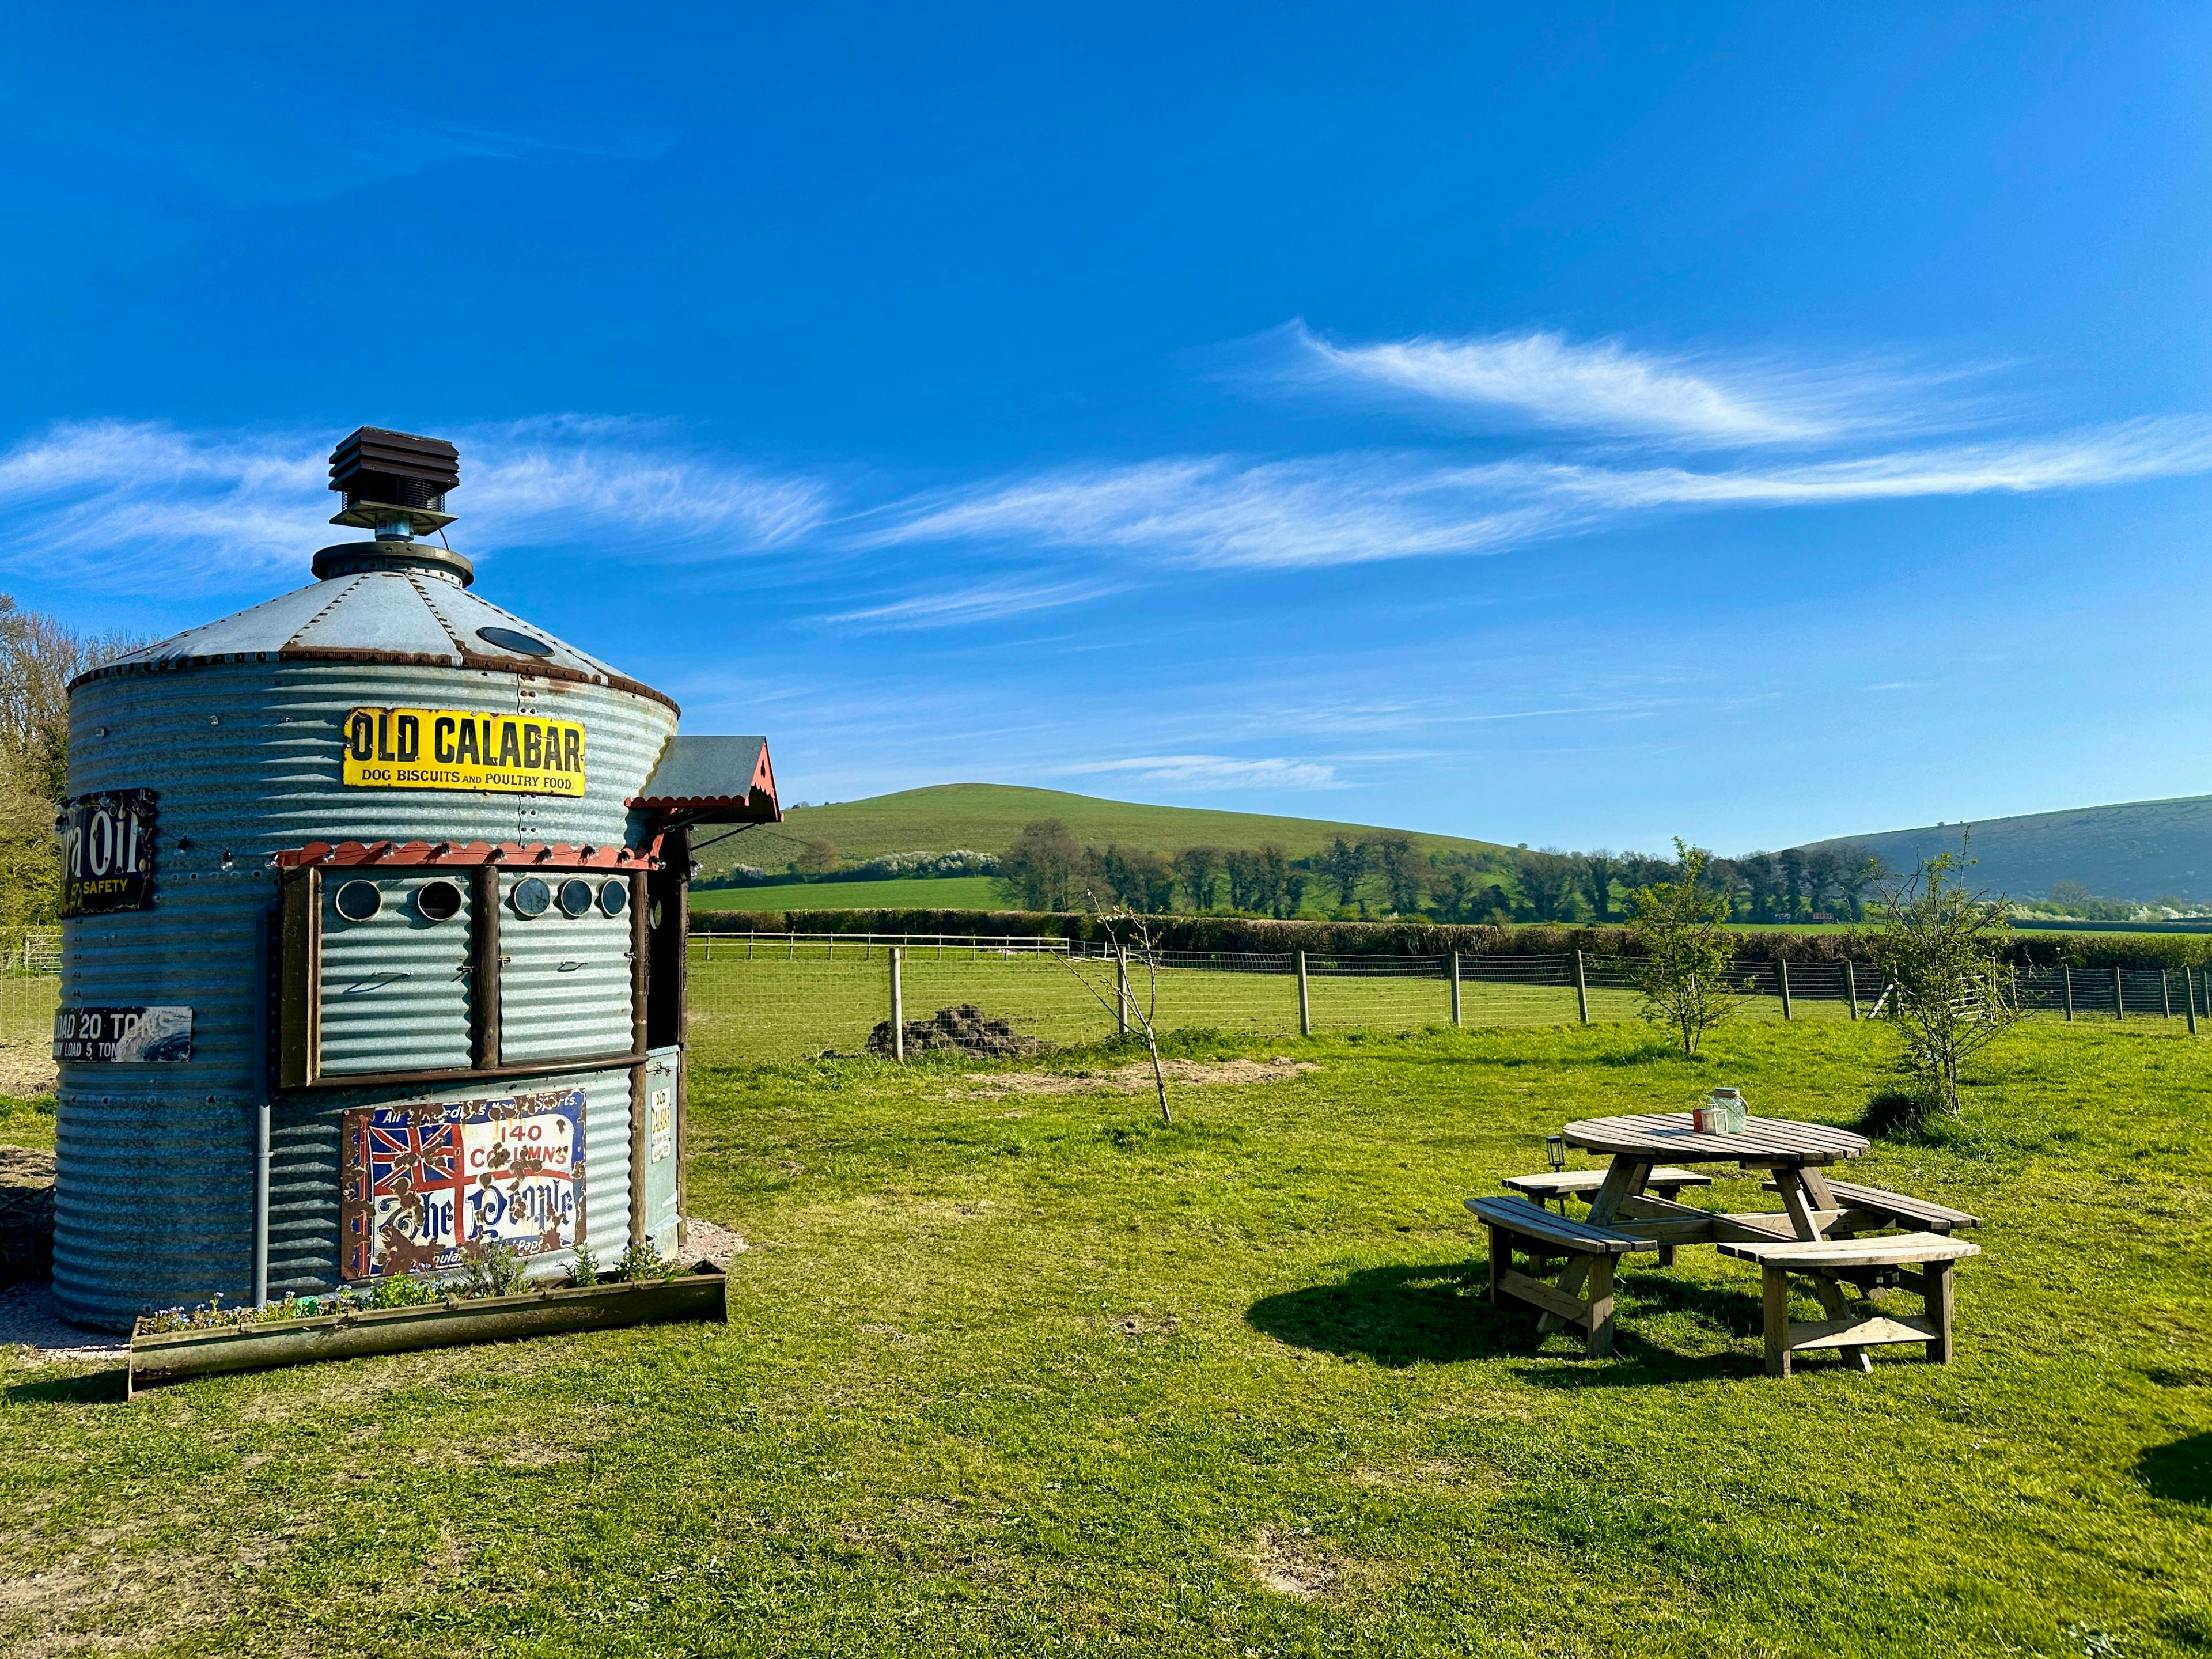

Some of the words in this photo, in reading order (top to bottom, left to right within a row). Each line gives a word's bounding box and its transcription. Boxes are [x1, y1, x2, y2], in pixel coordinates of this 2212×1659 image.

[351, 714, 419, 762] OLD
[434, 717, 581, 774] CALABAR
[362, 769, 391, 781] DOG
[397, 770, 460, 783] BISCUITS
[485, 773, 539, 787] POULTRY
[84, 878, 128, 895] SAFETY
[79, 1013, 101, 1039] 20
[110, 1013, 174, 1039] TONS
[65, 1042, 82, 1057] LOAD
[501, 1124, 542, 1143] 140
[470, 1146, 567, 1168] CLMNS
[377, 1192, 454, 1241] The
[465, 1179, 573, 1240] People
